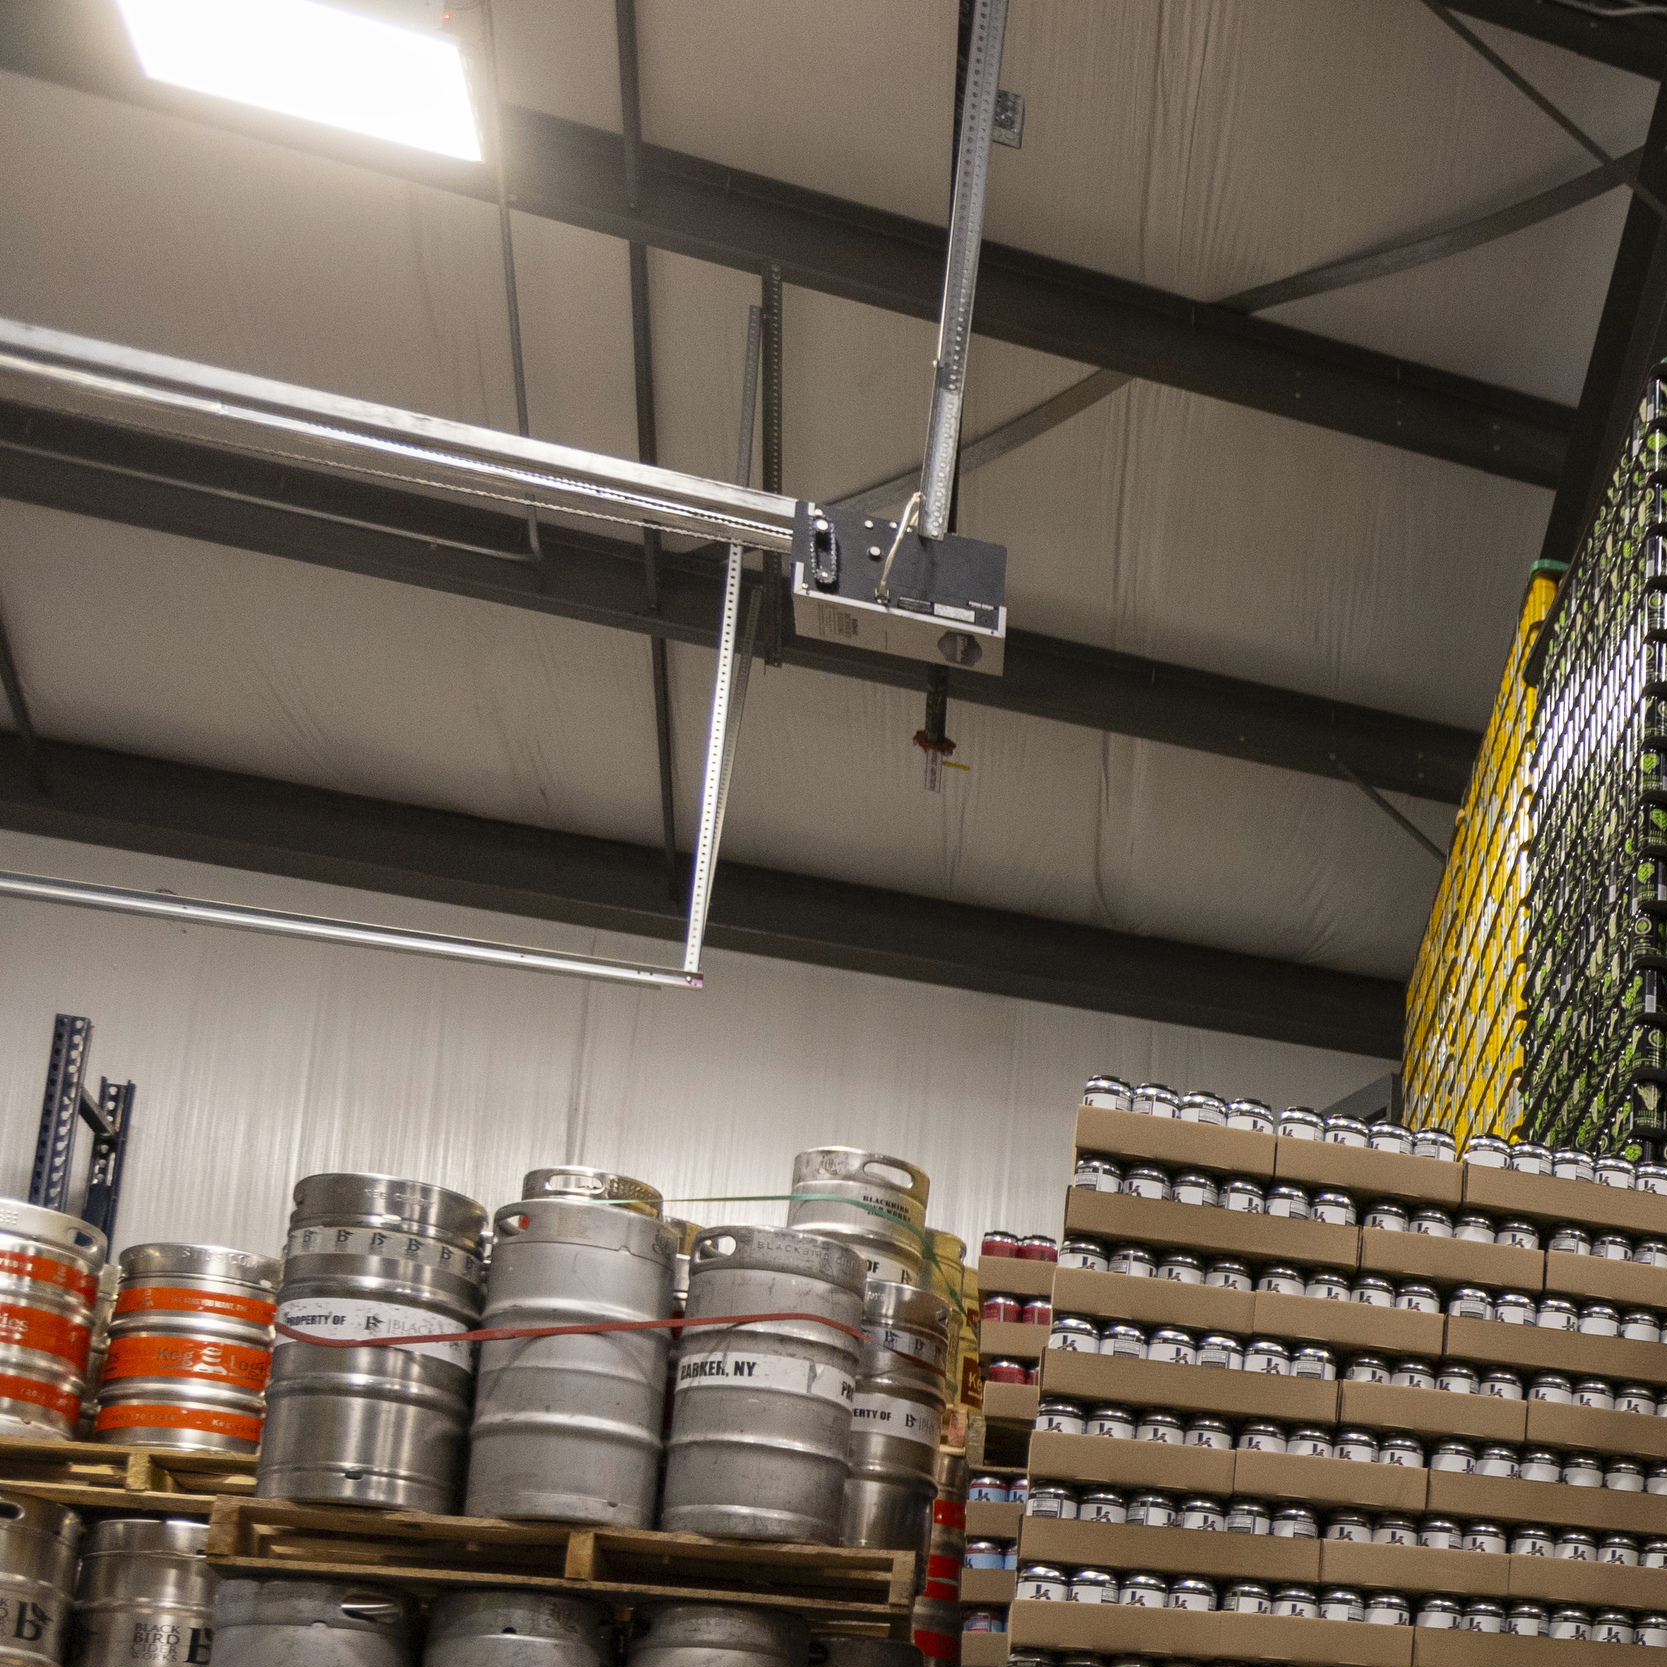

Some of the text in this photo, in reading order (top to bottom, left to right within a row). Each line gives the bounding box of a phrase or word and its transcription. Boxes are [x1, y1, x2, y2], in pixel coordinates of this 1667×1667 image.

[332, 1315, 347, 1325] OF
[157, 1347, 194, 1367] Keg
[734, 1361, 757, 1377] NY
[880, 1411, 892, 1421] OF
[135, 1622, 180, 1635] BLACK
[133, 1632, 181, 1646] BIRD
